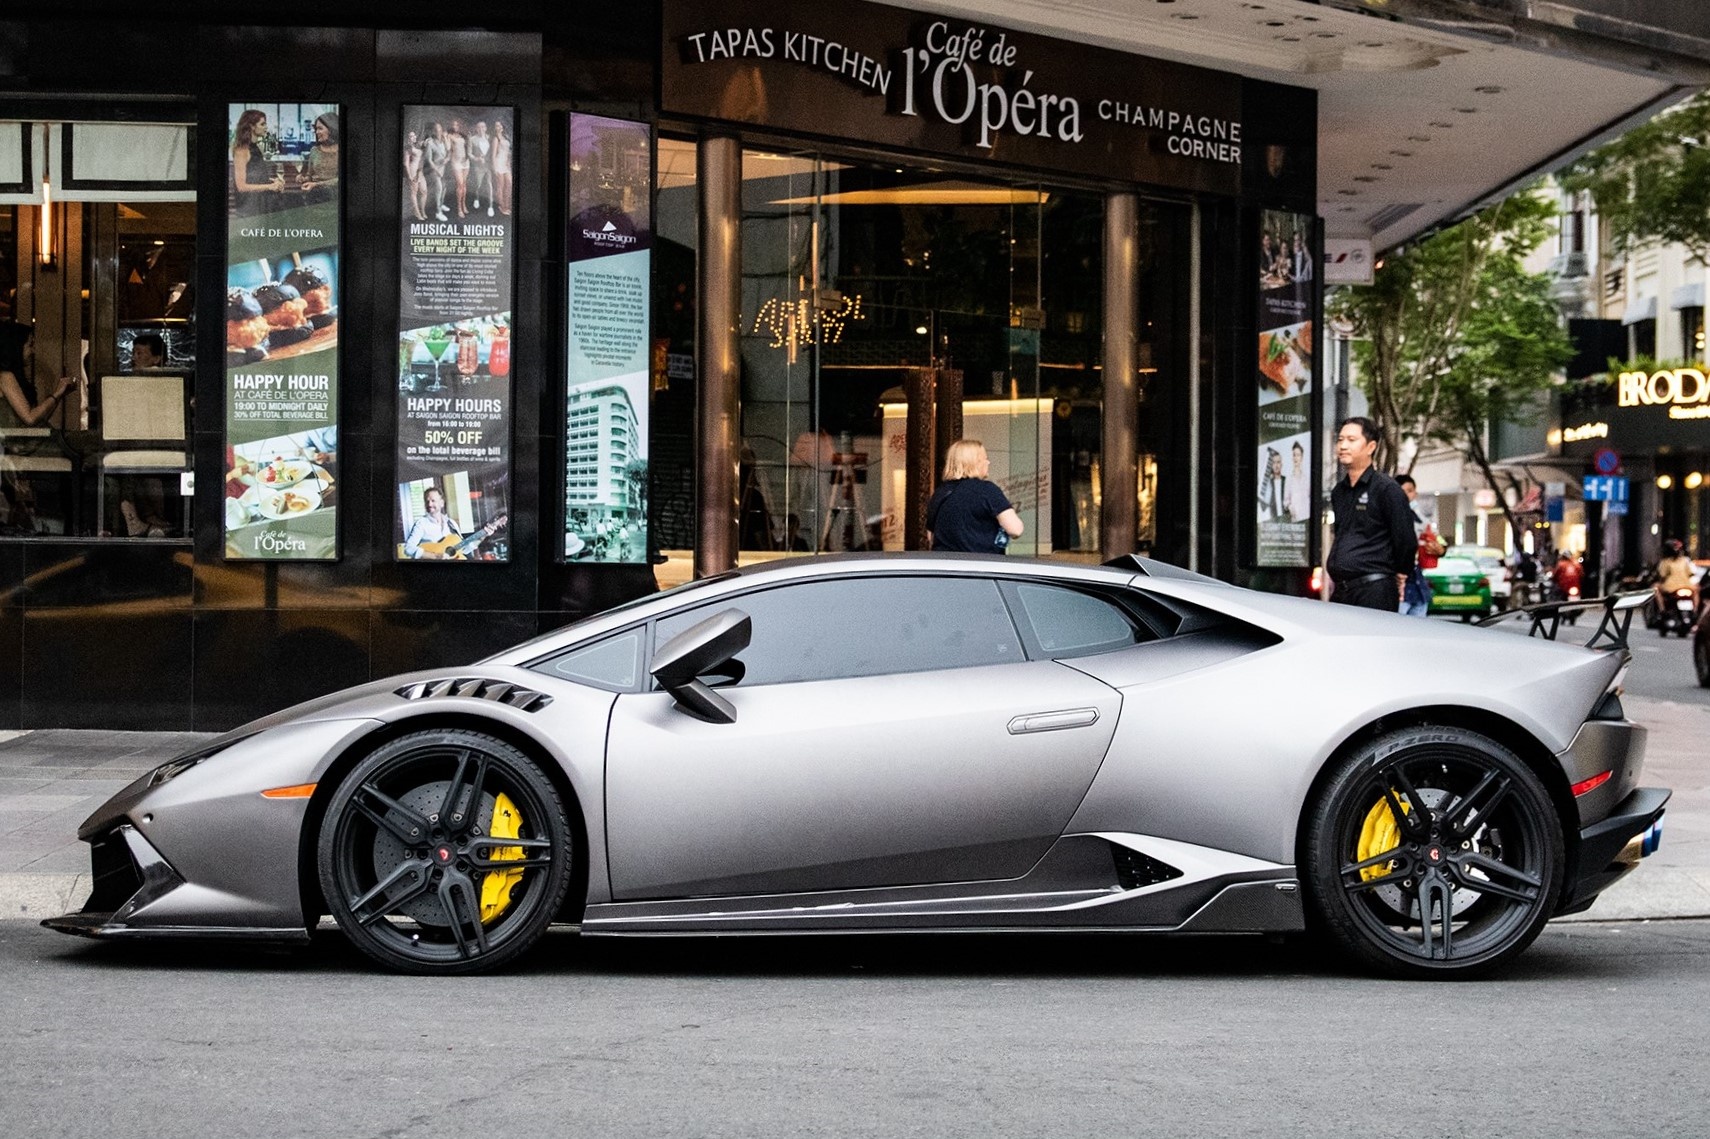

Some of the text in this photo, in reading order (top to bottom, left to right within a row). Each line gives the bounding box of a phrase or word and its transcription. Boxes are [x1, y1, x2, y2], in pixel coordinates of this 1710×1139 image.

[927, 21, 1016, 66] Café de
[688, 28, 892, 96] TAPAS KITCHEN
[1099, 101, 1242, 142] CHAMPAGNE
[1167, 135, 1242, 164] CORNER
[241, 226, 266, 238] CAFÉ
[268, 229, 282, 238] DE
[410, 223, 505, 236] MUSICAL NIGHTS
[410, 238, 425, 246] LIVE
[449, 239, 462, 247] SET
[464, 239, 475, 247] THE
[477, 240, 504, 248] GROOVE
[233, 374, 329, 390] HAPPY HOUR
[233, 389, 329, 400] AT CAFÉ DE L'OPERA
[234, 402, 329, 412] 19:00 TO MIDNIGHT DAILY
[407, 398, 502, 413] HAPPY HOURS
[249, 411, 262, 419] OFF
[262, 411, 281, 419] TOTAL
[282, 411, 314, 420] BEVERAGE
[315, 412, 329, 420] BILL
[415, 412, 438, 420] SAIGON
[489, 413, 502, 421] BAR
[427, 420, 441, 428] from
[424, 430, 483, 445] 50% OFF
[418, 446, 431, 454] the
[432, 446, 450, 455] total
[451, 446, 486, 457] beverage
[487, 447, 501, 455] bill
